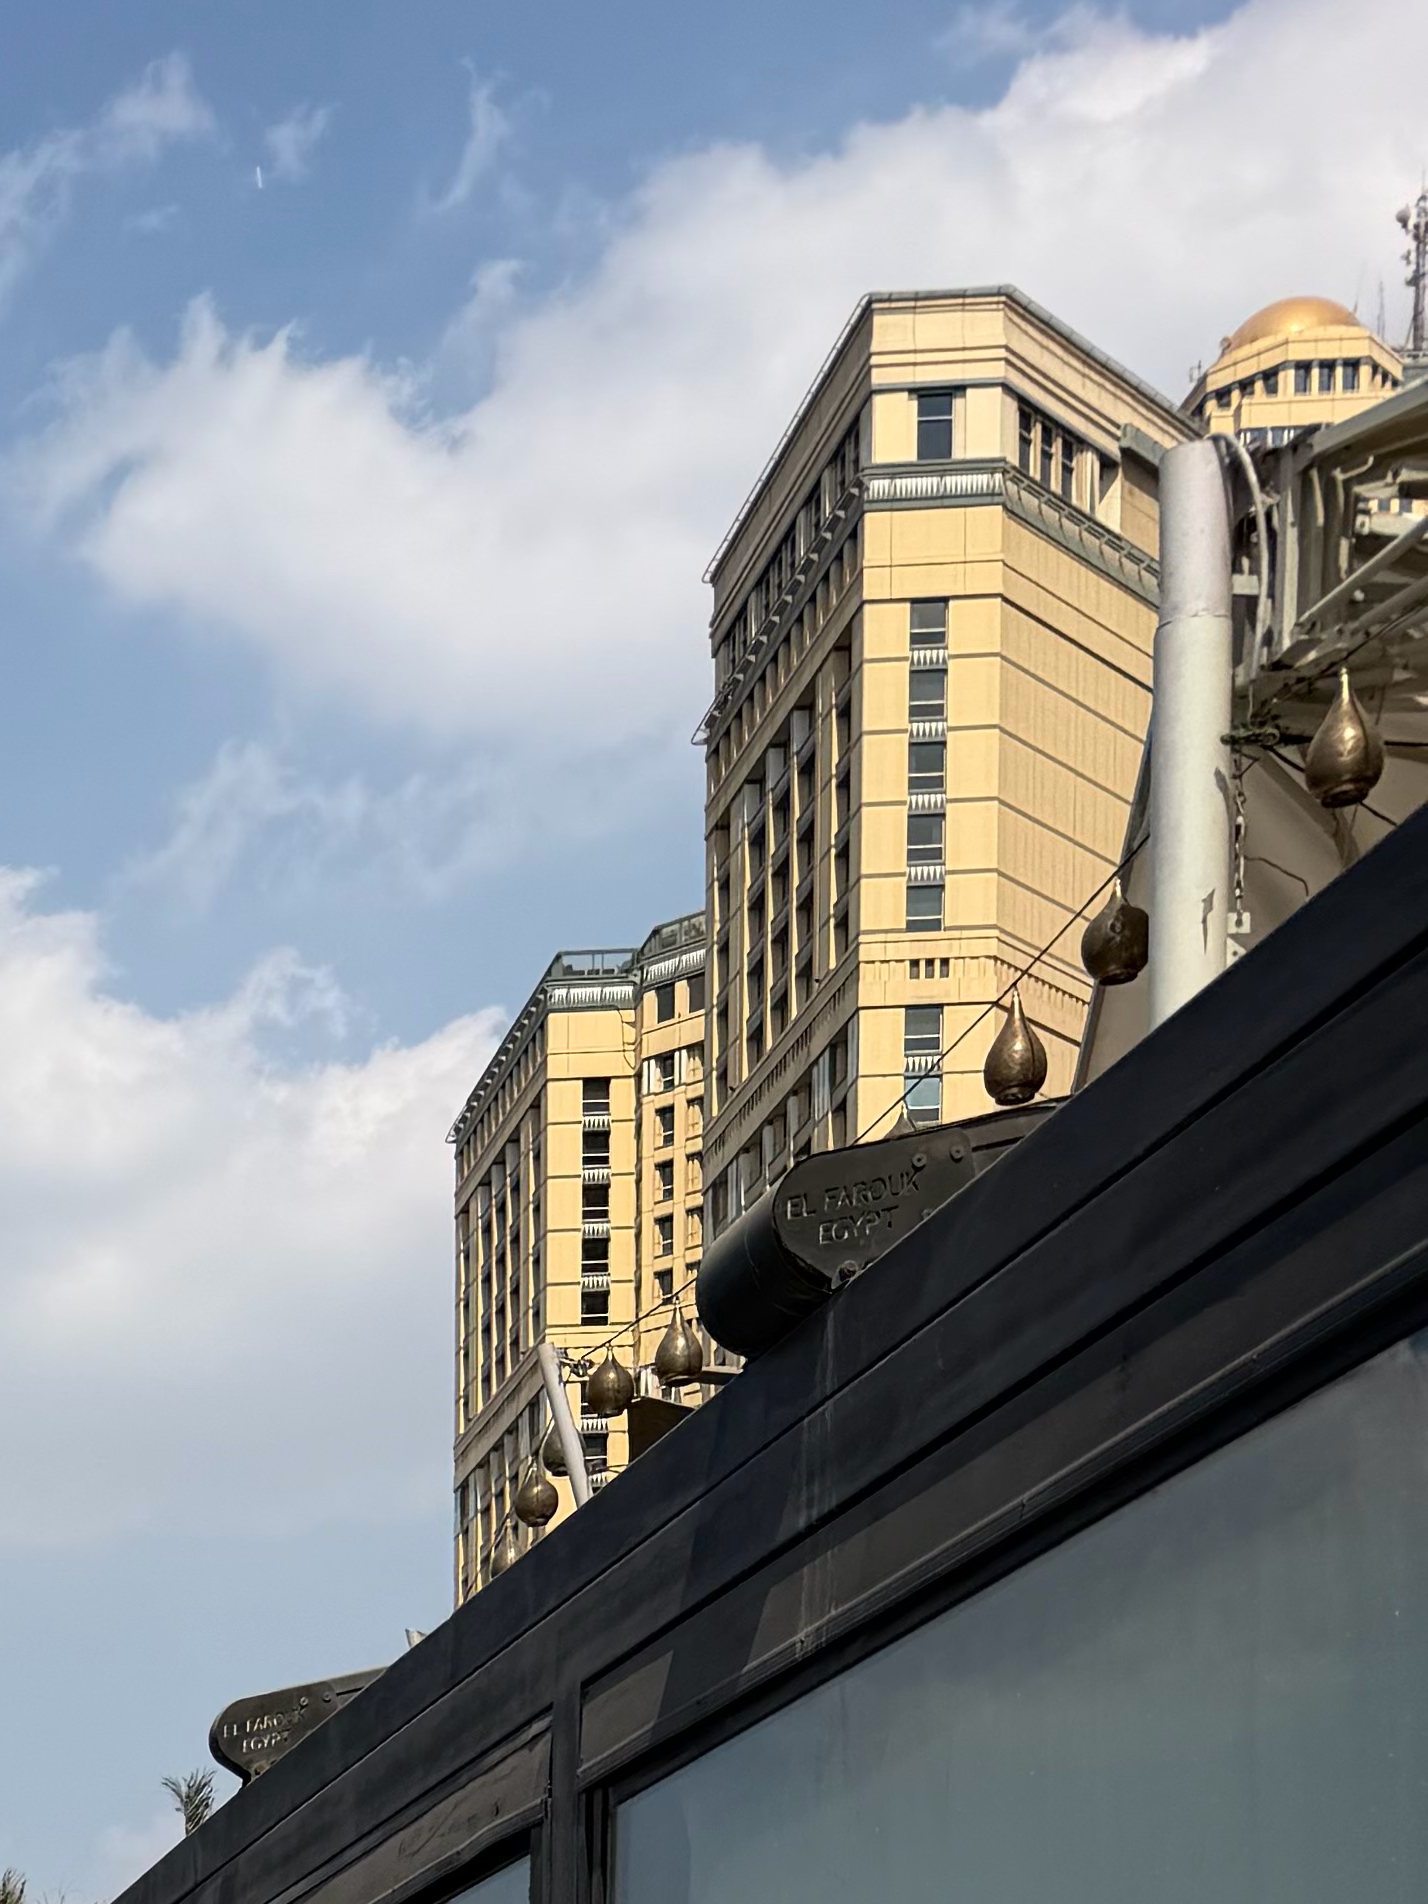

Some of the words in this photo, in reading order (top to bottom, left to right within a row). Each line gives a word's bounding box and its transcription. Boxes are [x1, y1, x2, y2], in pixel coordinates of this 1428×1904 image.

[787, 1192, 817, 1220] EL
[824, 1171, 920, 1213] FAROUK
[819, 1204, 899, 1245] EGYPT
